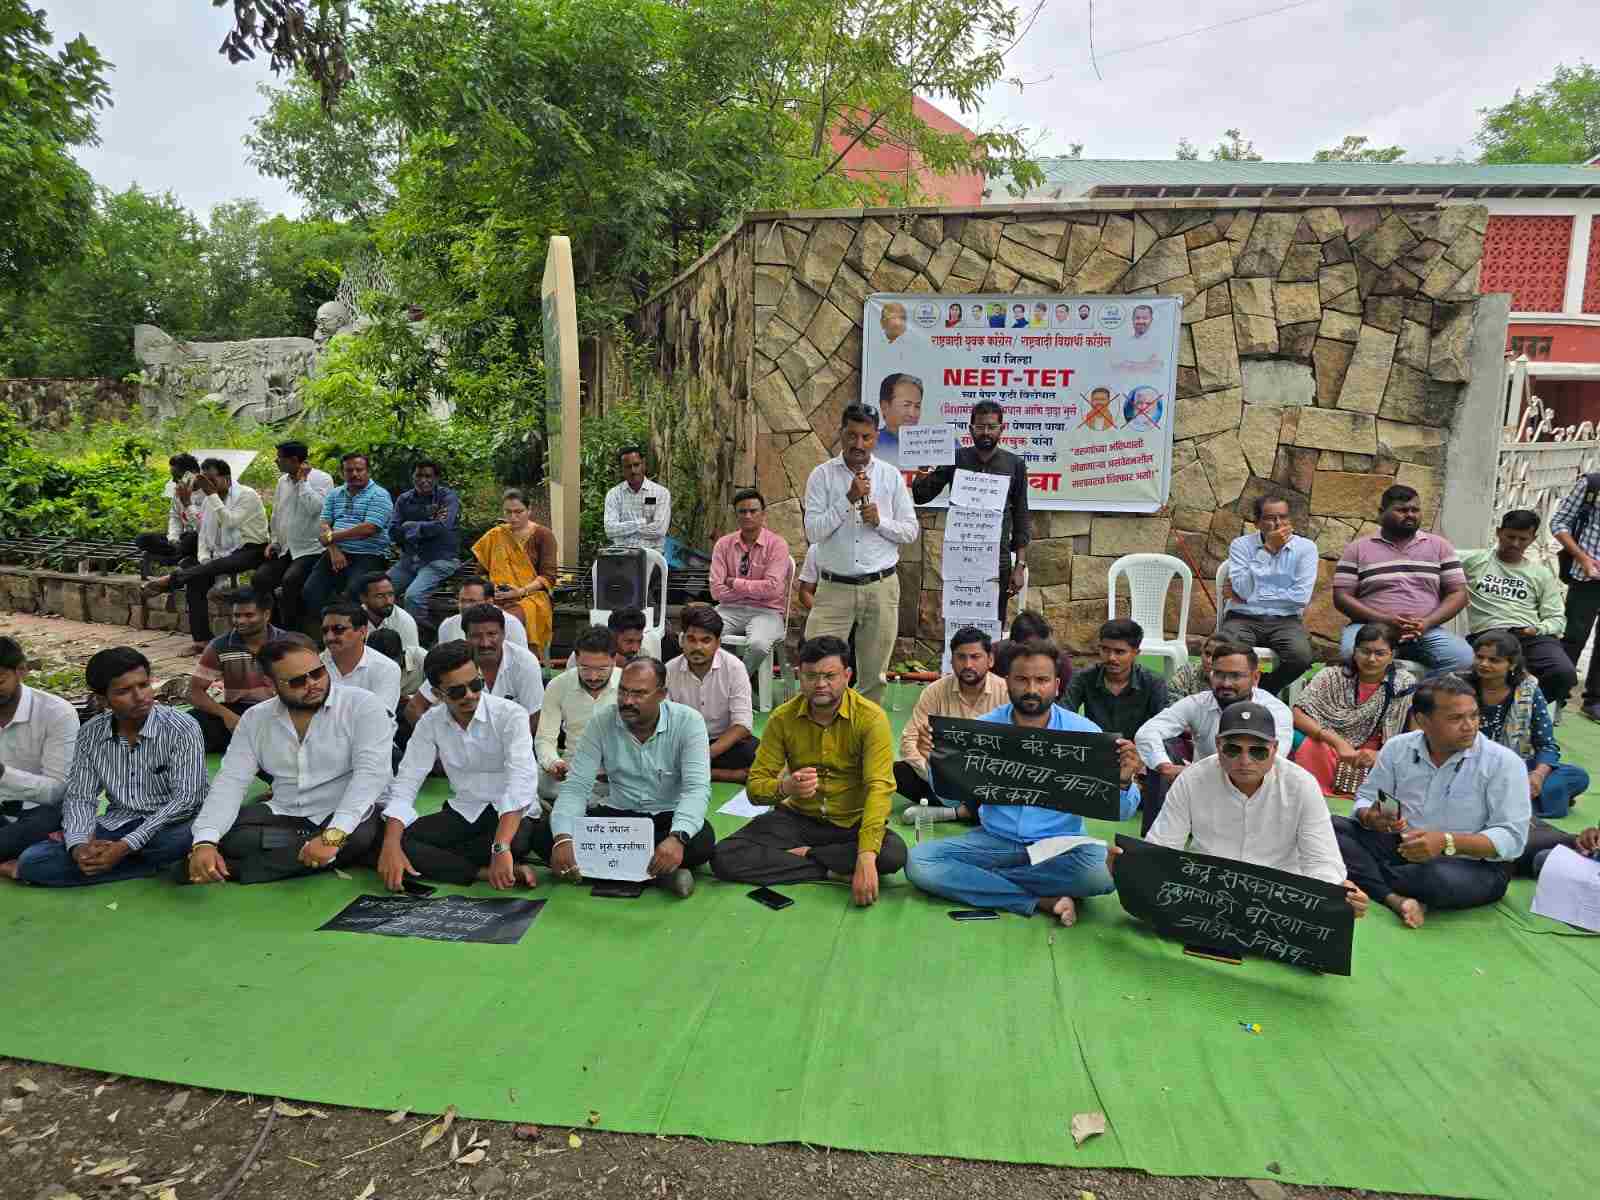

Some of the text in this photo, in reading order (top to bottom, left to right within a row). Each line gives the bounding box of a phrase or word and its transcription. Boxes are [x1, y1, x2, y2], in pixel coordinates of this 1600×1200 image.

[1004, 352, 1033, 365] जिल्हा
[943, 368, 1075, 387] NEET-TET
[1031, 434, 1054, 446] यांना
[1483, 574, 1525, 588] SUPER
[1476, 582, 1528, 600] MARIO
[973, 733, 1003, 751] करा
[1020, 734, 1049, 757] बंद
[1050, 742, 1092, 762] करा
